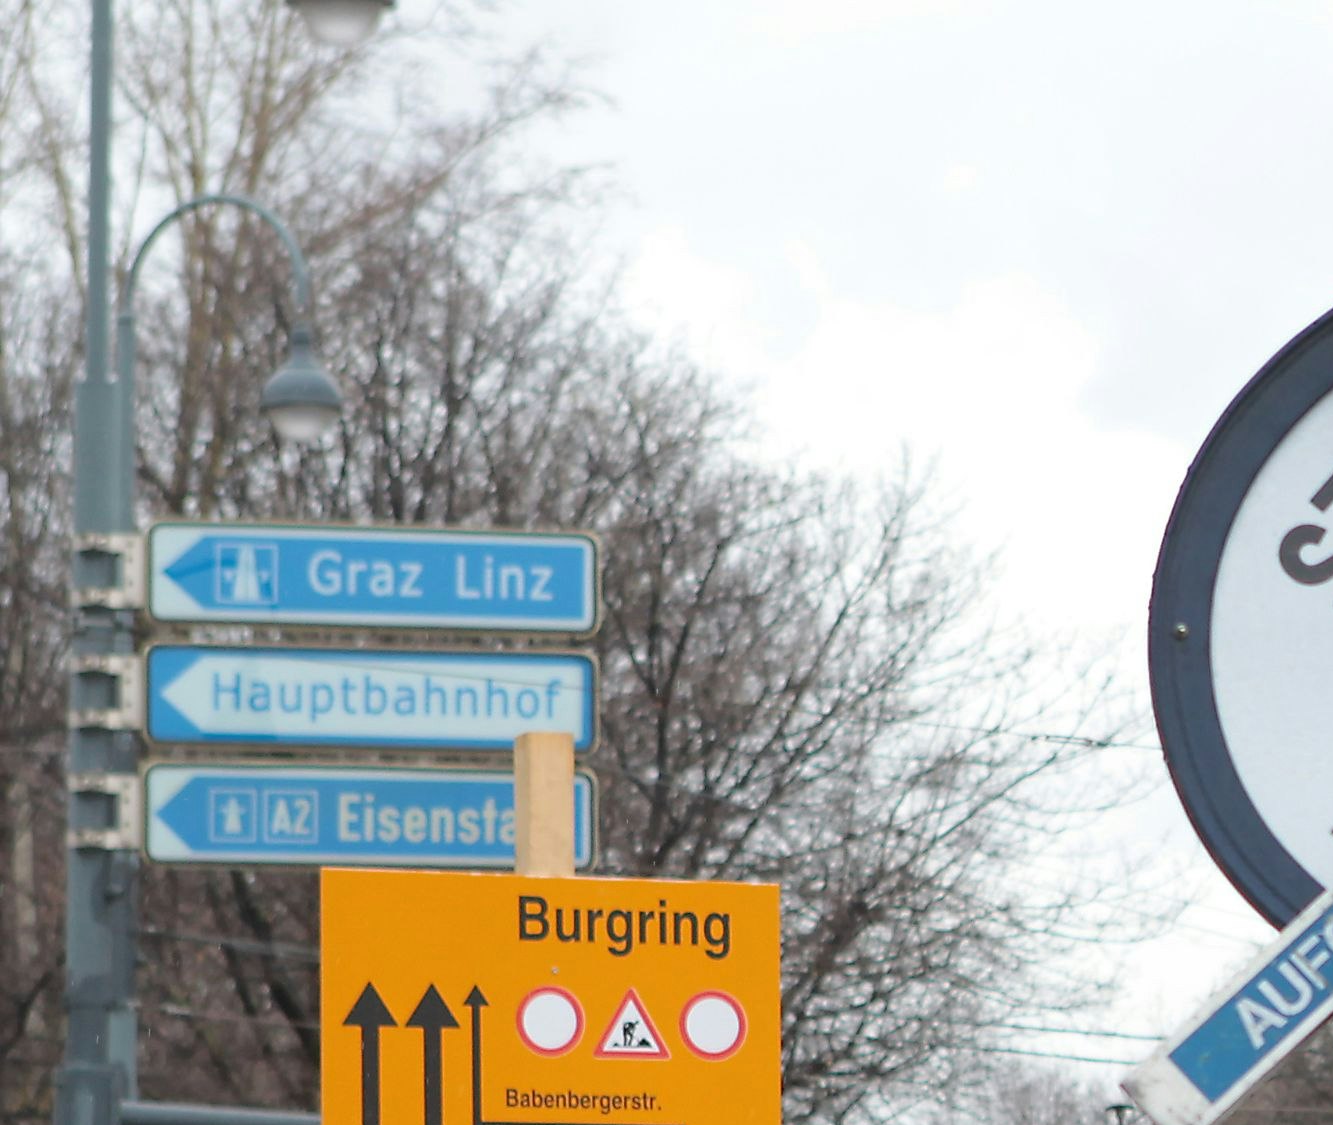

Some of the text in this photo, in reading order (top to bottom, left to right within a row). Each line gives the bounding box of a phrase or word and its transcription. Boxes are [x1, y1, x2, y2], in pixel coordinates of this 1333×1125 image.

[307, 551, 554, 603] Graz Linz
[211, 672, 563, 723] Hauptbahnhof
[271, 793, 515, 845] A2 Eisensta
[518, 894, 731, 960] Burgring
[505, 1088, 663, 1114] Babenbergerstr.
